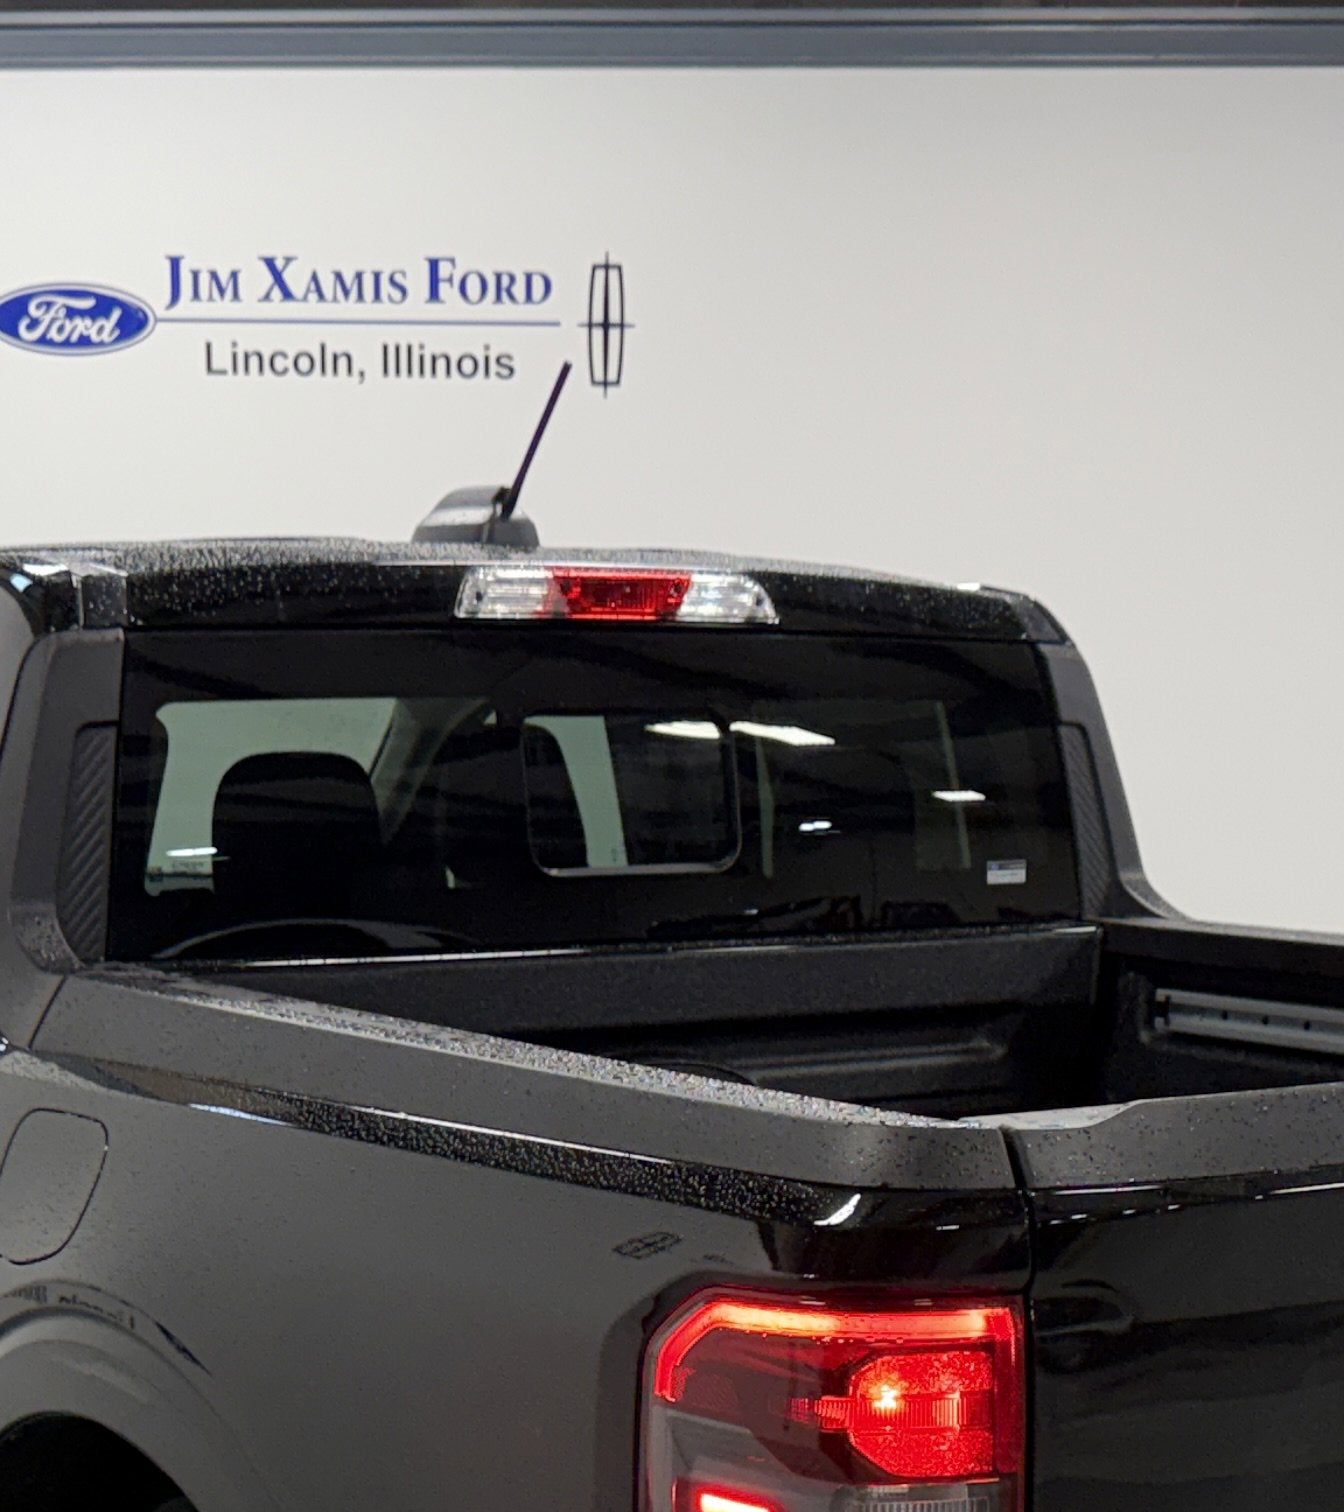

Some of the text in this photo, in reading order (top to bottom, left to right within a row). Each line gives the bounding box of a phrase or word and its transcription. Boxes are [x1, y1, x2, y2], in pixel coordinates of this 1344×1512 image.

[164, 255, 552, 311] JIM XAMIS FORD
[17, 295, 122, 347] Ford
[204, 342, 515, 384] Lincoln, Illinois
